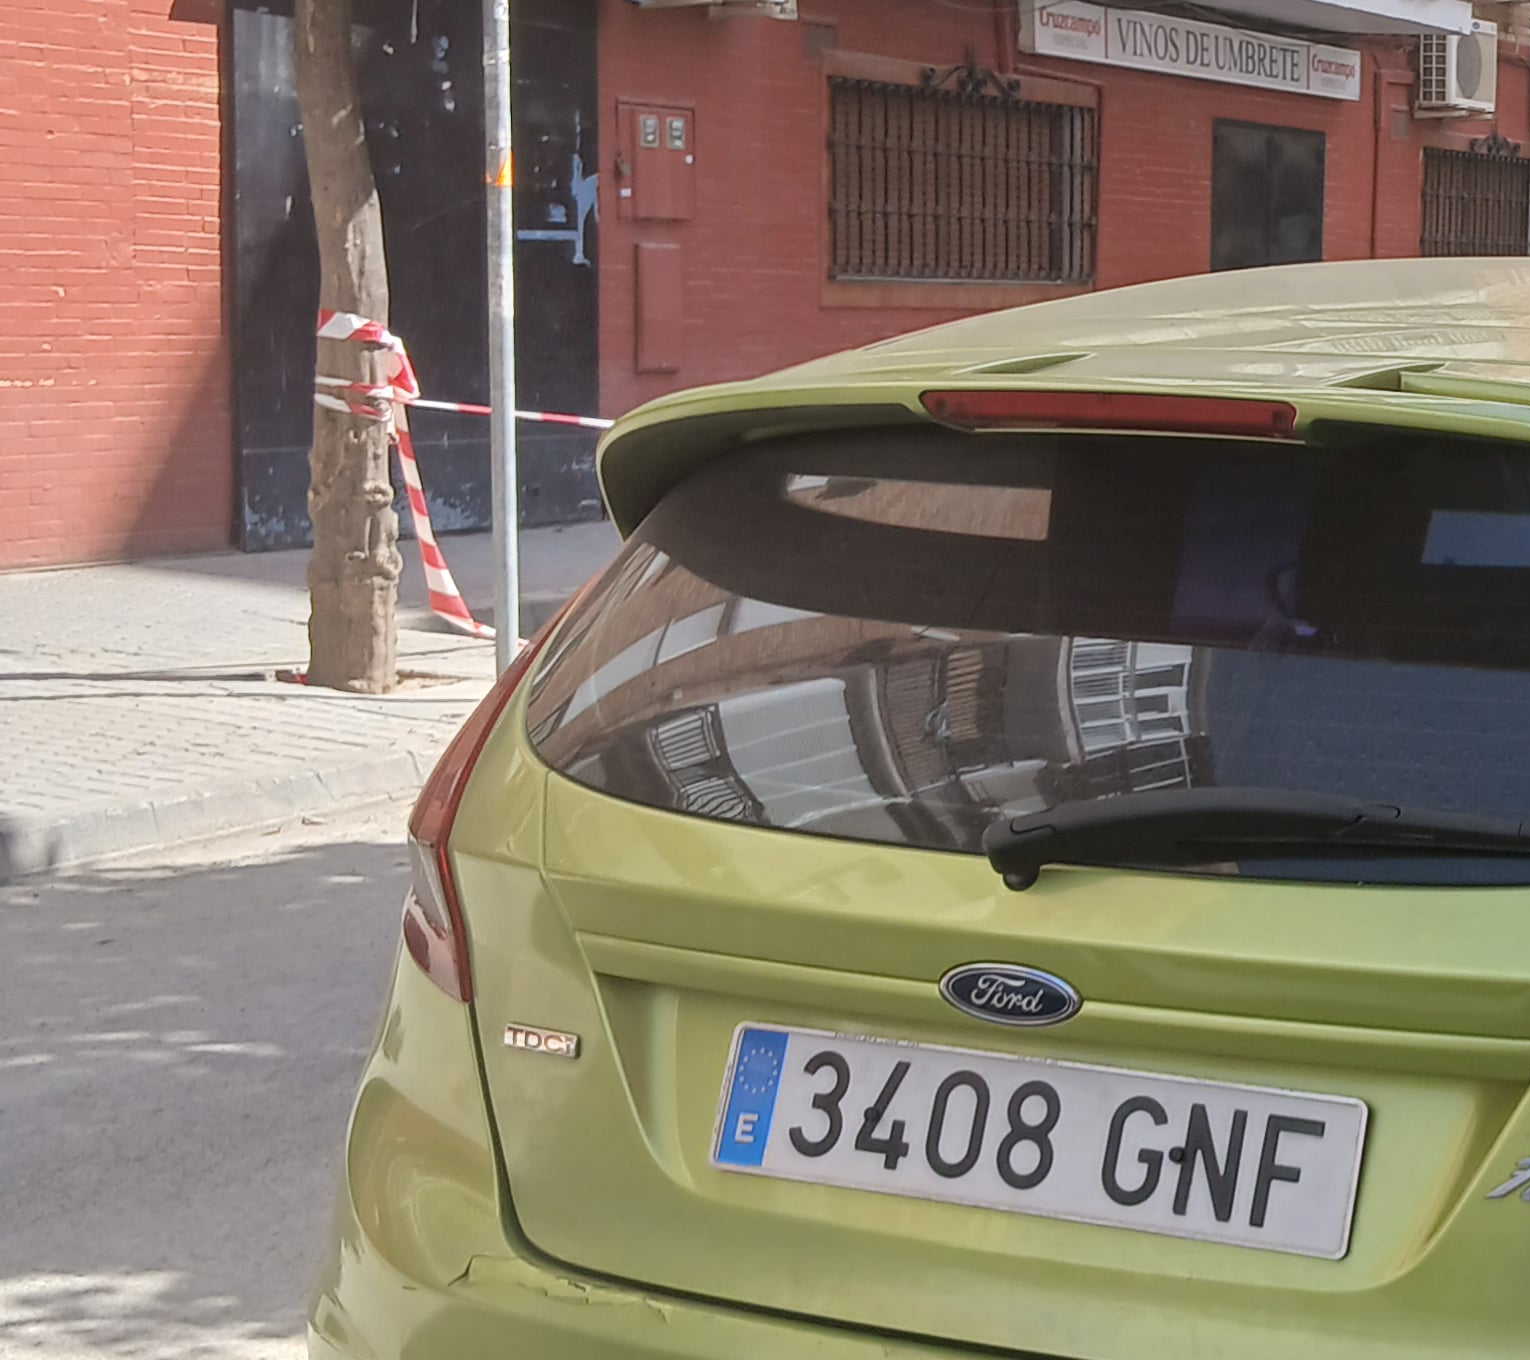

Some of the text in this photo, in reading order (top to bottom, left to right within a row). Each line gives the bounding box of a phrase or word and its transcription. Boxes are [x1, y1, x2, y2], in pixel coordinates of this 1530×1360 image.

[1039, 6, 1101, 37] Cruzcampo
[1117, 18, 1301, 83] VINOS DE UMBRETE
[1312, 53, 1356, 81] Cruzcampo
[970, 973, 1045, 1015] Ford
[506, 1025, 575, 1056] TDCi
[734, 1111, 759, 1145] E
[788, 1050, 1325, 1228] 3408 GNF
